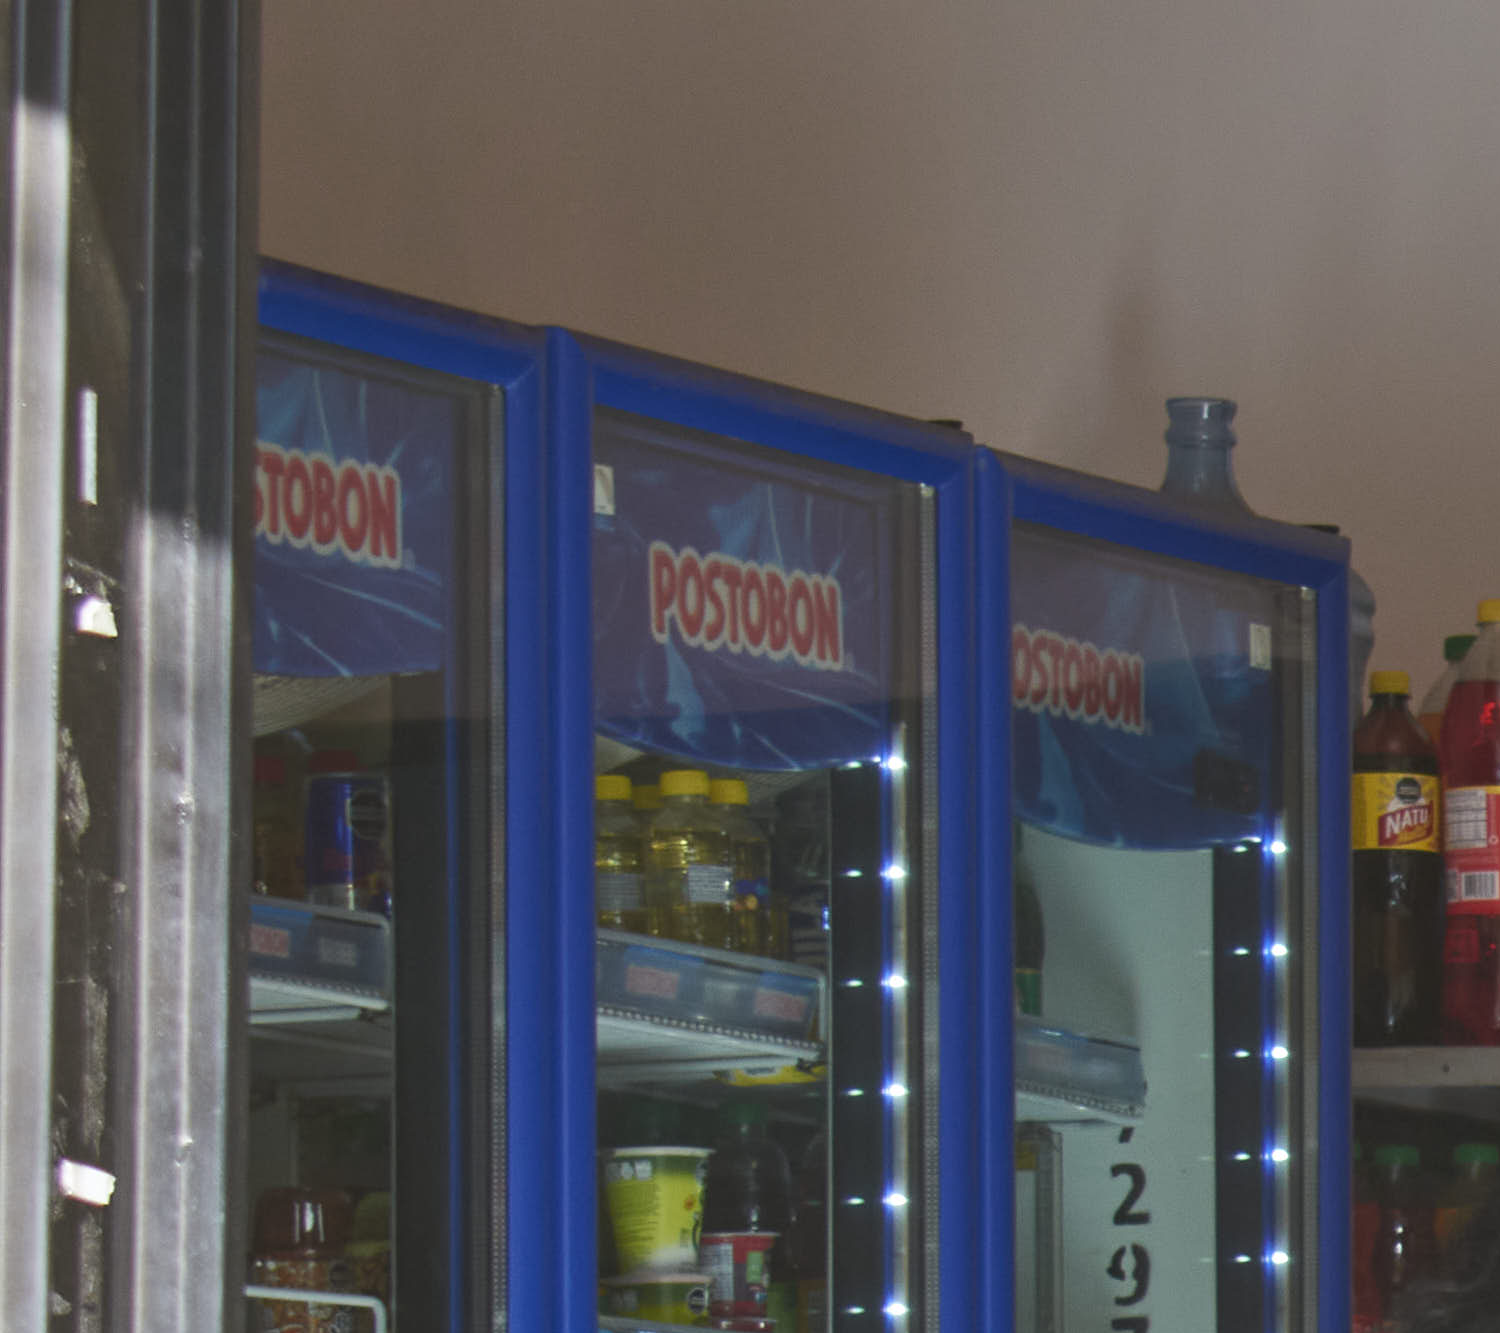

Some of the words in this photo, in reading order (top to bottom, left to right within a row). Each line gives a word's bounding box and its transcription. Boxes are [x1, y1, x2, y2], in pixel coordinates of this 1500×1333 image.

[254, 446, 402, 568] TOBON
[651, 543, 843, 668] POSTOBON
[1013, 625, 1144, 734] OSTOBON
